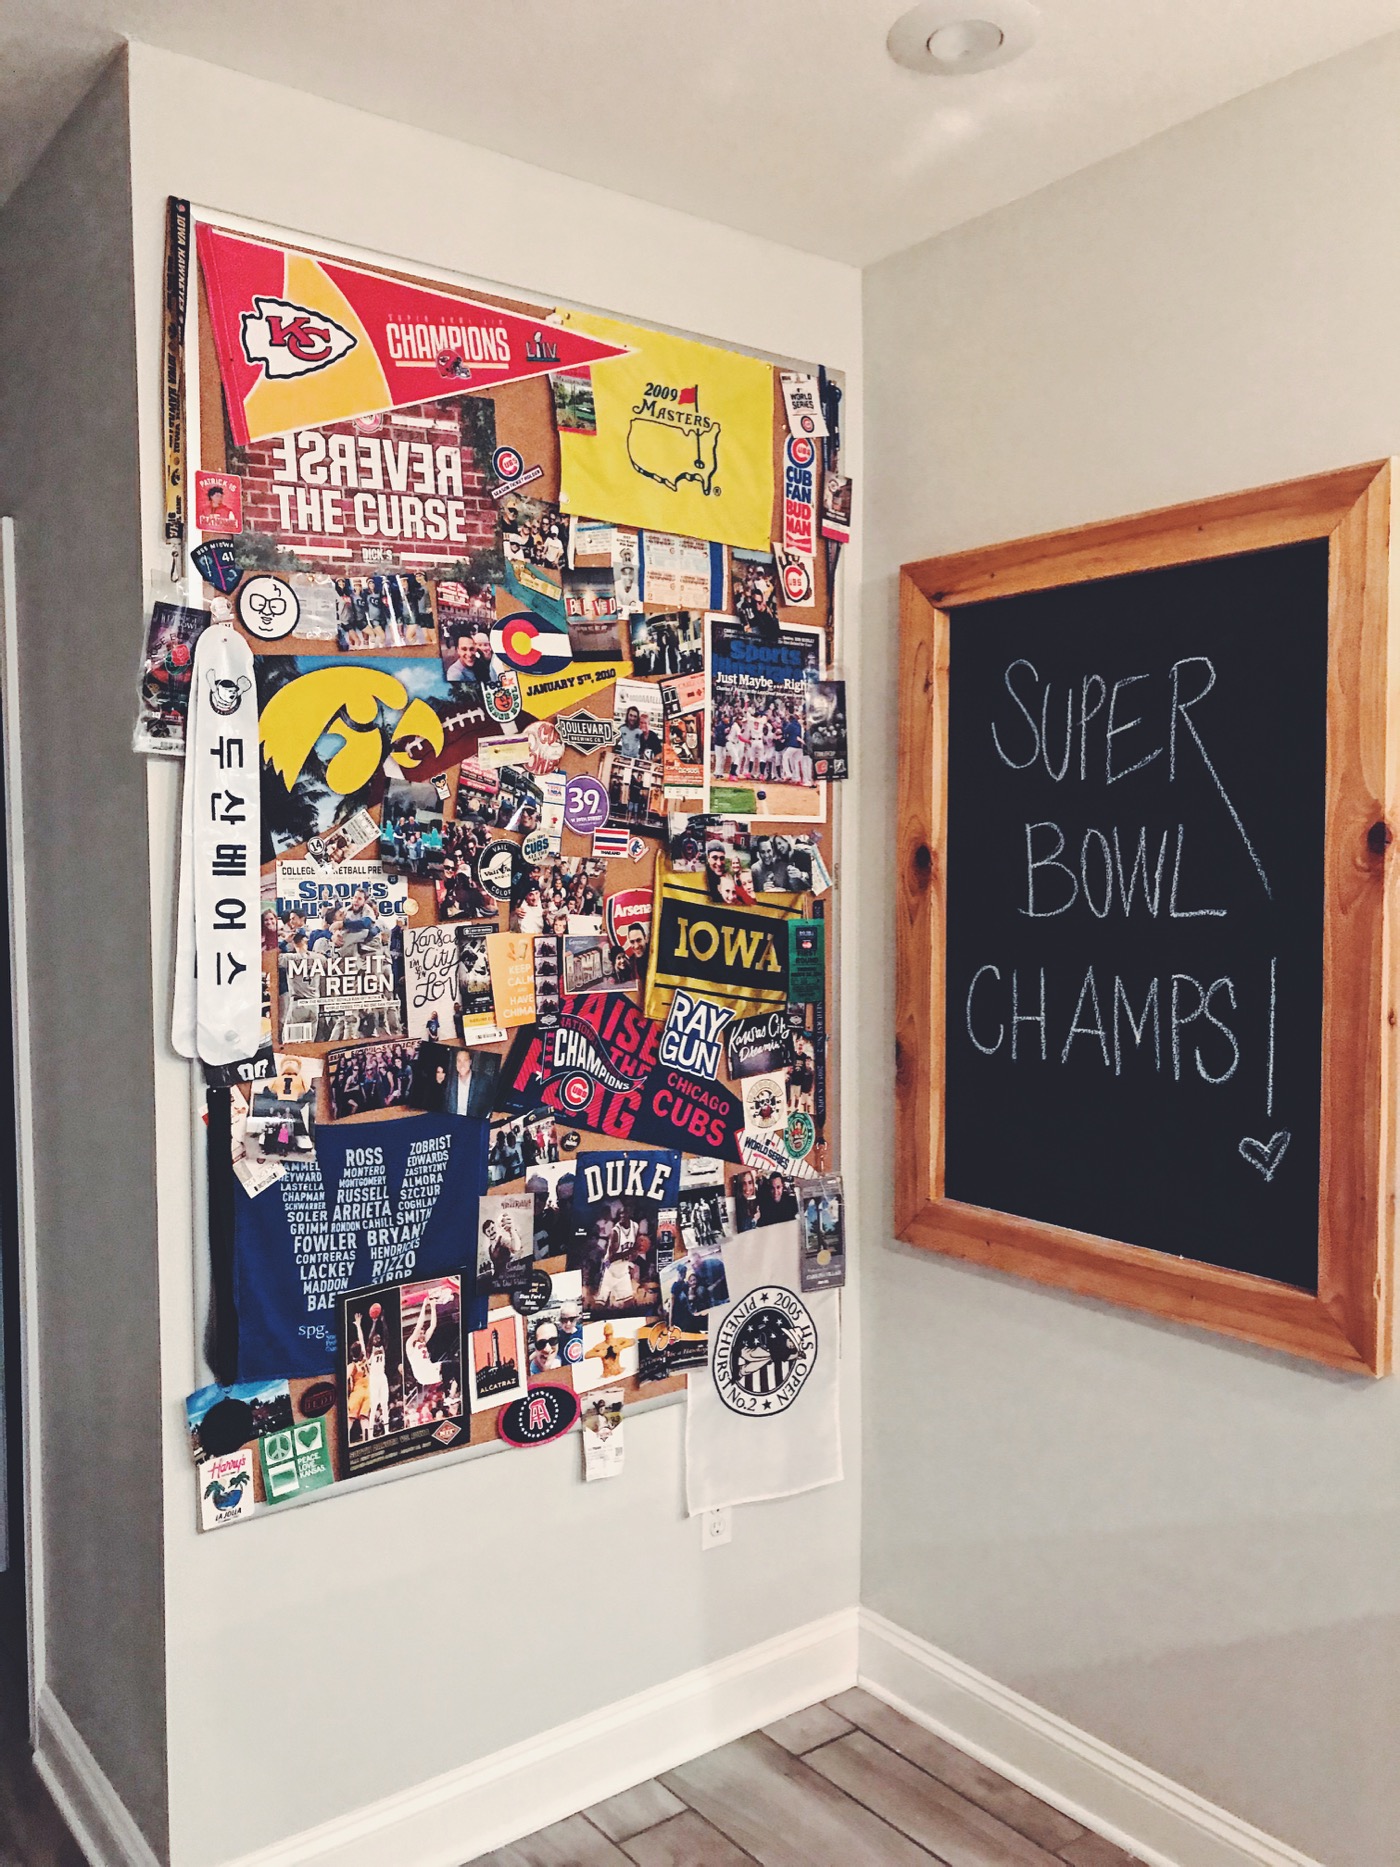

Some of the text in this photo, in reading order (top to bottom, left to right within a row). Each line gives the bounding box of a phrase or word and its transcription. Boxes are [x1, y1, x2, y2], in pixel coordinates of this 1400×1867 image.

[176, 214, 186, 245] IOWA
[264, 315, 333, 362] KC
[386, 322, 511, 361] CHAMPIONS
[643, 382, 678, 402] 2009
[631, 398, 711, 429] MASTERS
[792, 401, 814, 410] SERIES
[199, 478, 238, 494] PATRICK IS
[785, 466, 812, 487] CUB
[785, 482, 812, 504] FAN
[272, 485, 345, 534] THE
[353, 492, 467, 543] CURSE
[785, 498, 812, 520] BUD
[785, 517, 812, 537] MAN
[210, 541, 235, 549] MIDWA
[222, 551, 235, 562] 41
[526, 677, 575, 697] JANUARY
[595, 668, 616, 682] 2010
[716, 671, 738, 685] Just
[783, 678, 808, 693] Righ
[561, 719, 612, 741] BOULEVARD
[570, 735, 593, 743] BREWING
[991, 657, 1273, 900] SUPER
[568, 787, 600, 815] 39
[310, 839, 322, 852] 14
[491, 844, 508, 853] VAIL
[524, 838, 549, 856] CUBS
[210, 735, 247, 986] 두산베어스
[281, 866, 316, 876] COLLEGE
[1018, 821, 1228, 918] BOWL
[298, 880, 389, 901] Sports
[613, 903, 652, 918] Arsena
[674, 917, 783, 973] IOWA
[287, 955, 386, 979] MAKE IT
[422, 947, 462, 977] City
[508, 964, 532, 974] KEEP
[326, 973, 394, 997] REIGN
[413, 970, 460, 1008] LOV
[507, 975, 534, 986] CALM
[509, 995, 534, 1005] HAVE
[503, 1006, 535, 1019] CHIMA
[670, 993, 728, 1044] RAY
[728, 1013, 791, 1057] Kansas City
[553, 1028, 630, 1090] CHAMPIONS
[662, 1031, 717, 1075] GUN
[667, 1072, 730, 1116] CHICAGO
[652, 1089, 727, 1147] CUBS
[409, 1134, 452, 1156] ZOBRIST
[744, 1136, 790, 1170] WORLD SERIES
[283, 1161, 321, 1172] AMMEL
[345, 1147, 384, 1167] ROSS
[407, 1150, 449, 1167] EDWARDS
[343, 1165, 386, 1178] MONTERO
[404, 1162, 448, 1177] ZASTRYZNY
[338, 1175, 387, 1188] MONTGOMERY
[401, 1172, 444, 1189] ALMORA
[584, 1159, 672, 1204] DUKE
[282, 1191, 326, 1203] CHAPMAN
[336, 1186, 390, 1204] RUSSELL
[399, 1184, 441, 1201] SZCZUR
[284, 1201, 327, 1211] SCHWARBER
[332, 1200, 392, 1222] ARRIETA
[397, 1196, 438, 1211] COGHLAN
[286, 1210, 328, 1223] SOLER
[290, 1216, 395, 1236] GRIMM RONDON CAHILL
[396, 1207, 433, 1226] SMITH
[294, 1232, 358, 1254] FOWLER
[366, 1220, 429, 1248] BRYANT
[295, 1250, 356, 1265] CONTRERAS
[370, 1237, 421, 1260] HENDRICKS
[300, 1261, 355, 1281] LACKEY
[371, 1250, 416, 1278] RIZZO
[303, 1277, 349, 1295] MADDON
[307, 1293, 336, 1312] BAE
[298, 1324, 329, 1339] spg.
[716, 1296, 757, 1390] PINEHURST
[773, 1292, 808, 1406] 2005 OPEN
[480, 1377, 517, 1394] ALCATRAZ
[207, 1454, 247, 1480] Harry's
[215, 1507, 242, 1522] LA JOLLA
